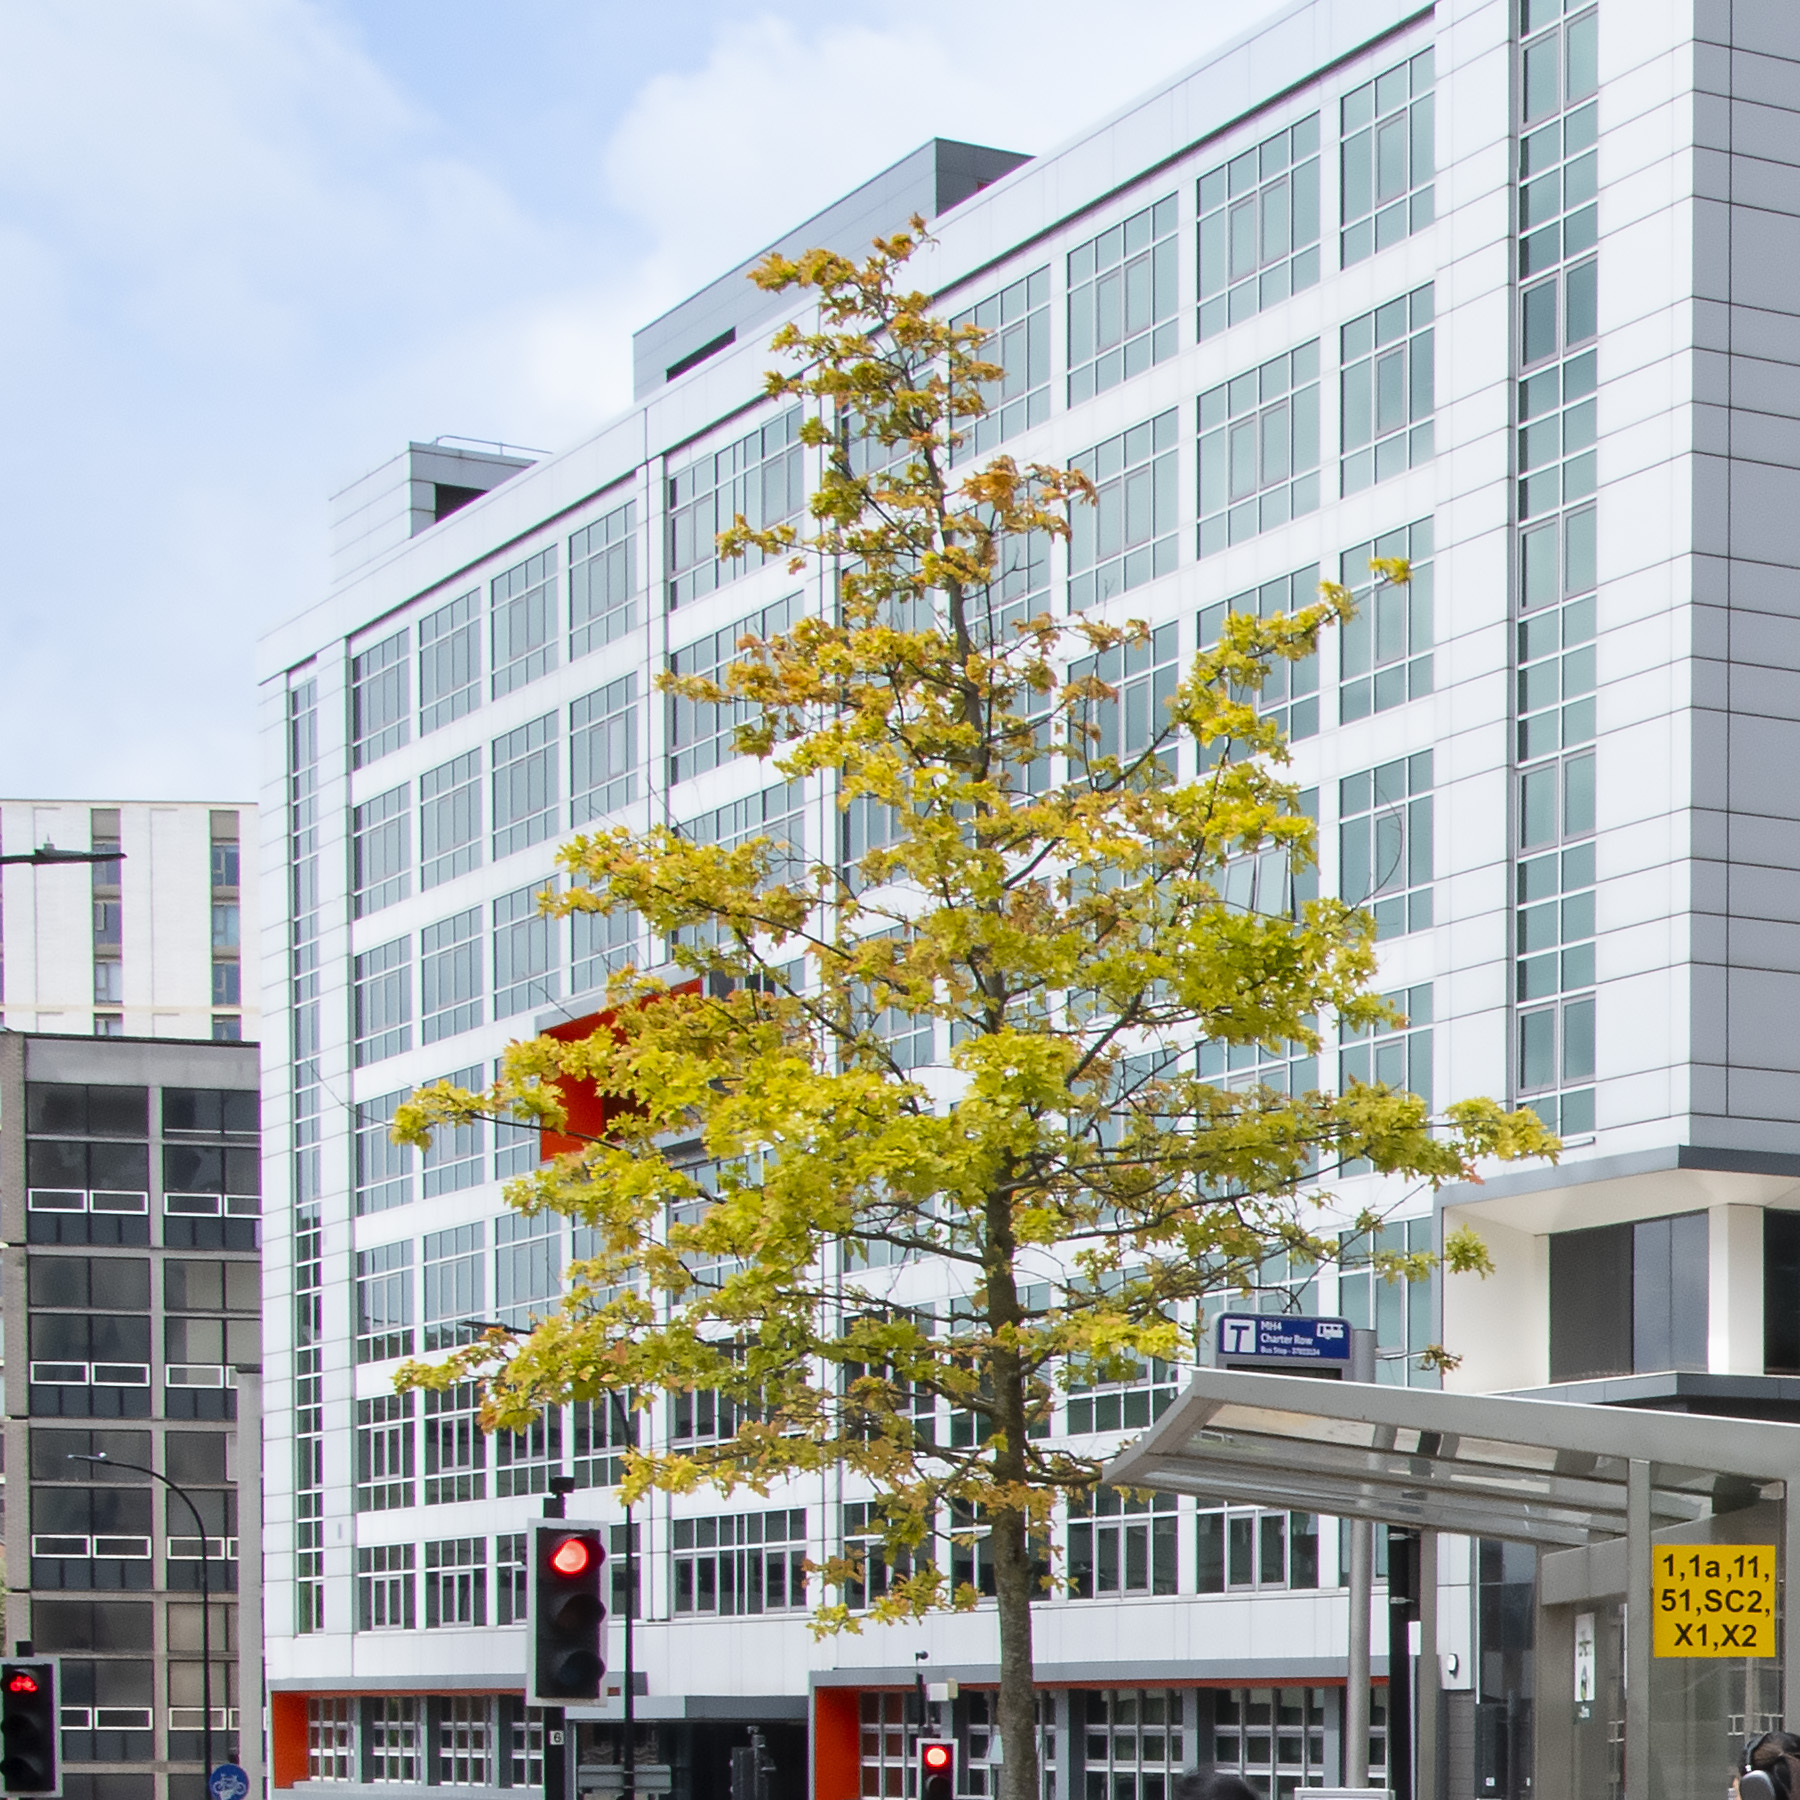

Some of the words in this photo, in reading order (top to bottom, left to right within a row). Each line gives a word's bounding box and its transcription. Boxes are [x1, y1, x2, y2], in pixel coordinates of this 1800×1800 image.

[1260, 1332, 1293, 1346] Charter
[1293, 1334, 1314, 1347] Row
[1673, 1622, 1758, 1652] X1,X2
